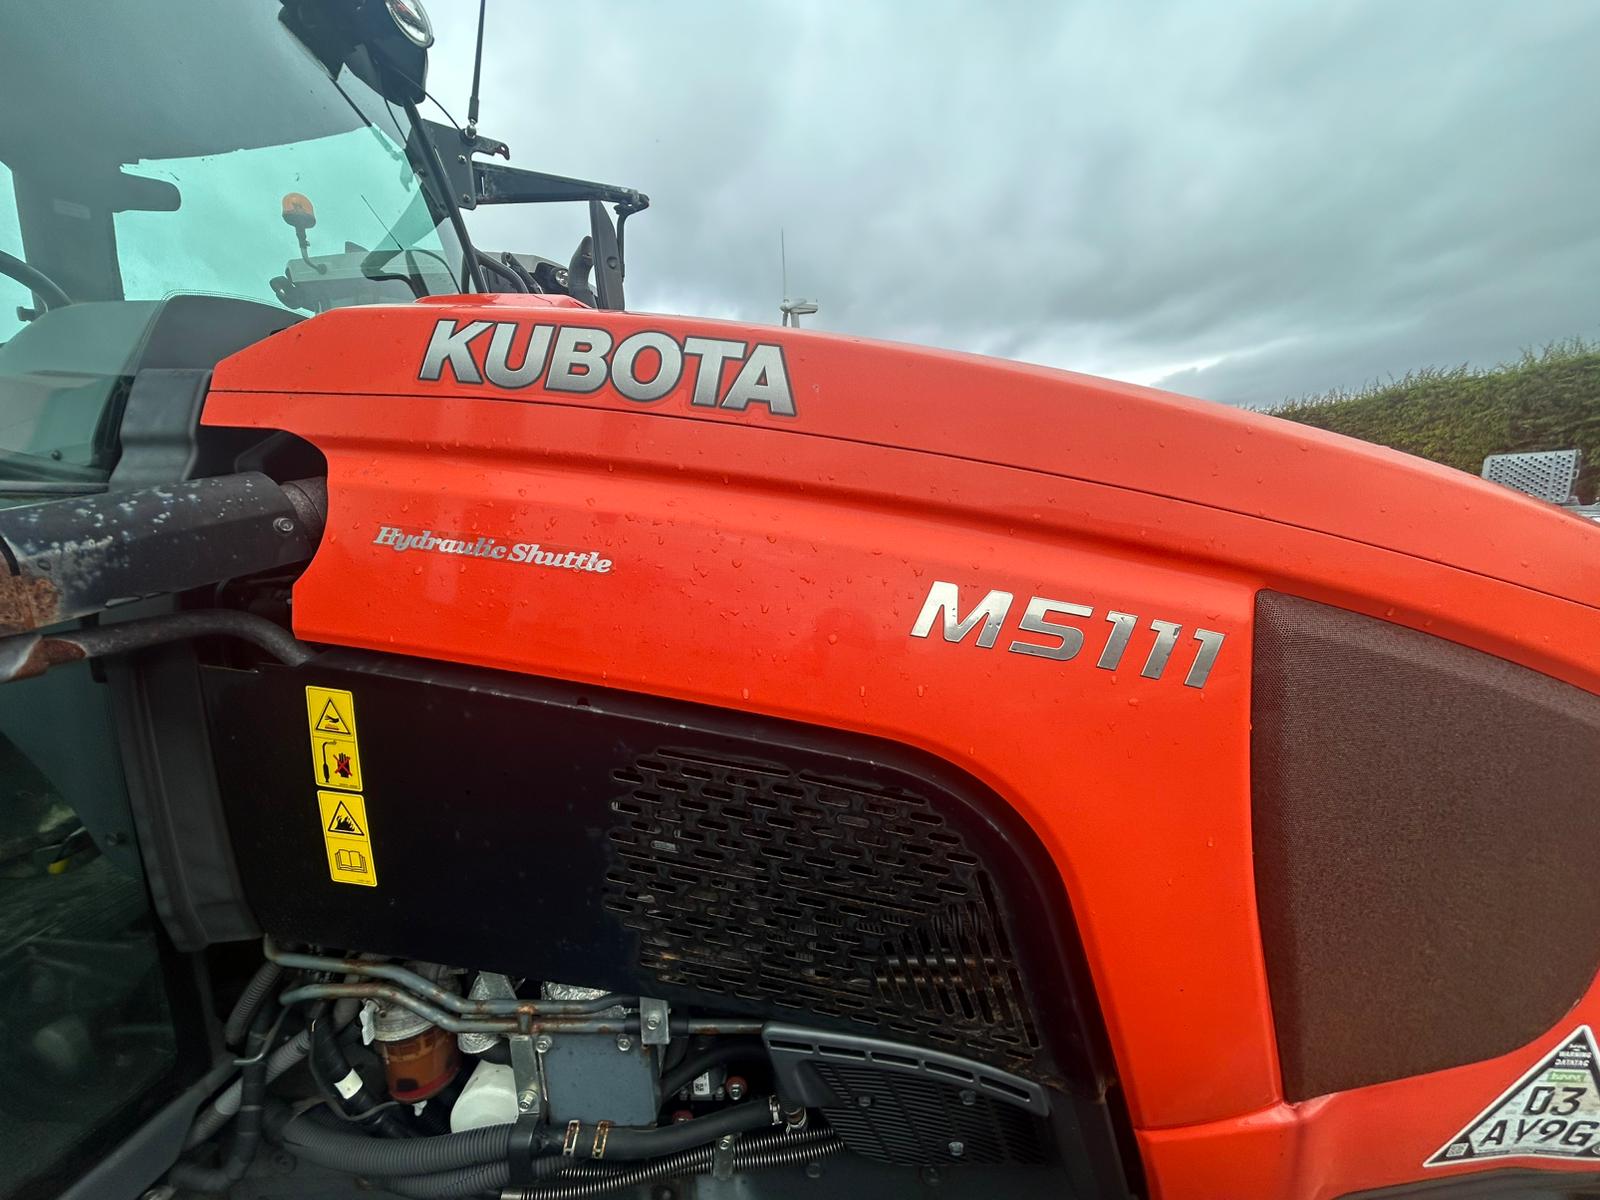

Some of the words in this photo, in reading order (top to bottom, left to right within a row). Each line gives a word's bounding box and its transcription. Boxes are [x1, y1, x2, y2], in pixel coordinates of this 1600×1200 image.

[418, 319, 797, 417] KUBOTA
[373, 526, 507, 559] Hydraulic
[508, 543, 613, 573] Shuttle
[910, 580, 1225, 689] M5111
